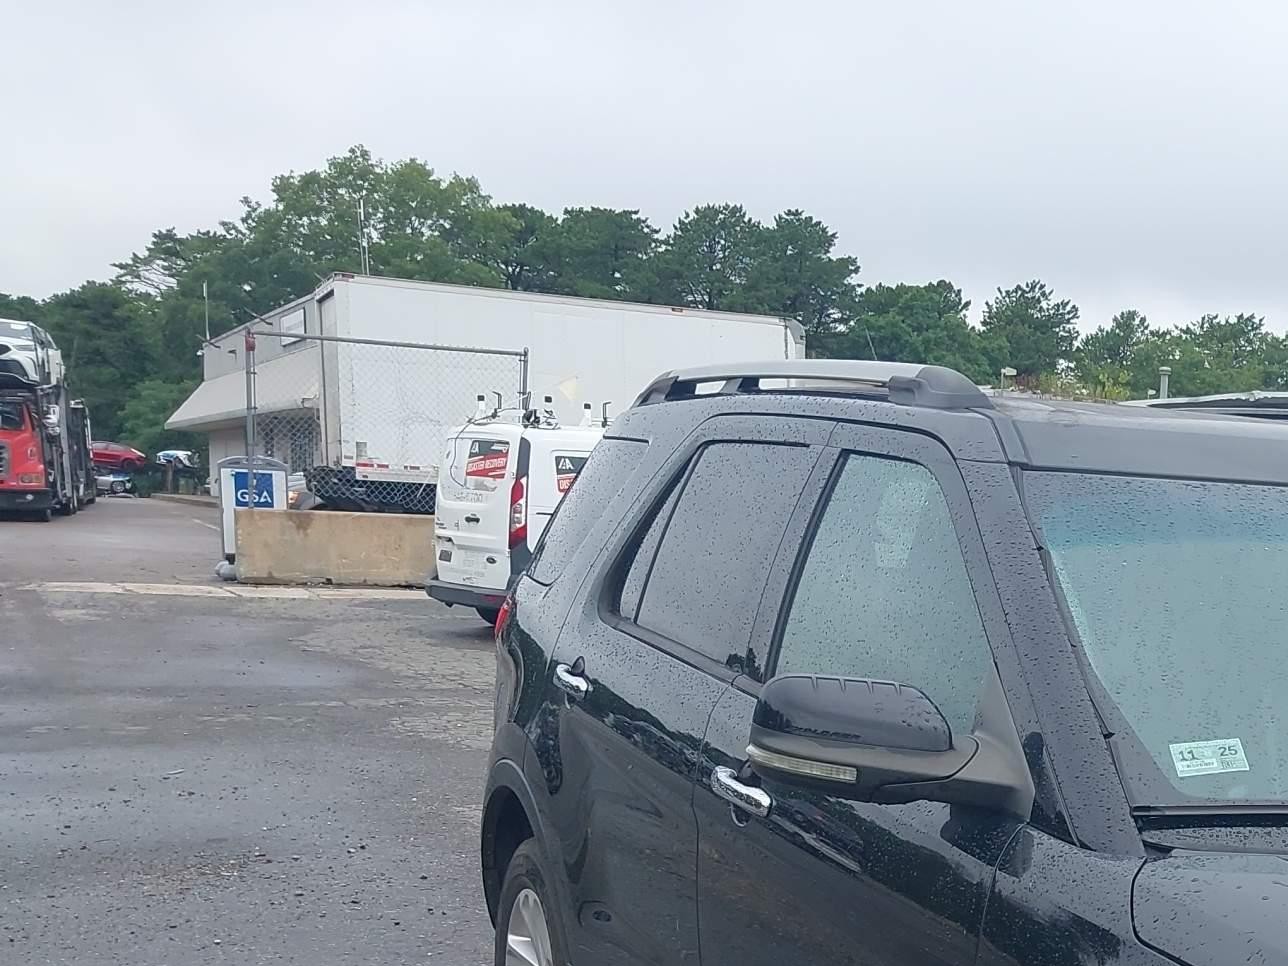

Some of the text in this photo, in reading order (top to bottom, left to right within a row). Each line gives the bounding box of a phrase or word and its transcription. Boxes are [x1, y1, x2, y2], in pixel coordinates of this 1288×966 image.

[237, 489, 272, 503] GSA
[1178, 745, 1238, 761] 11 25
